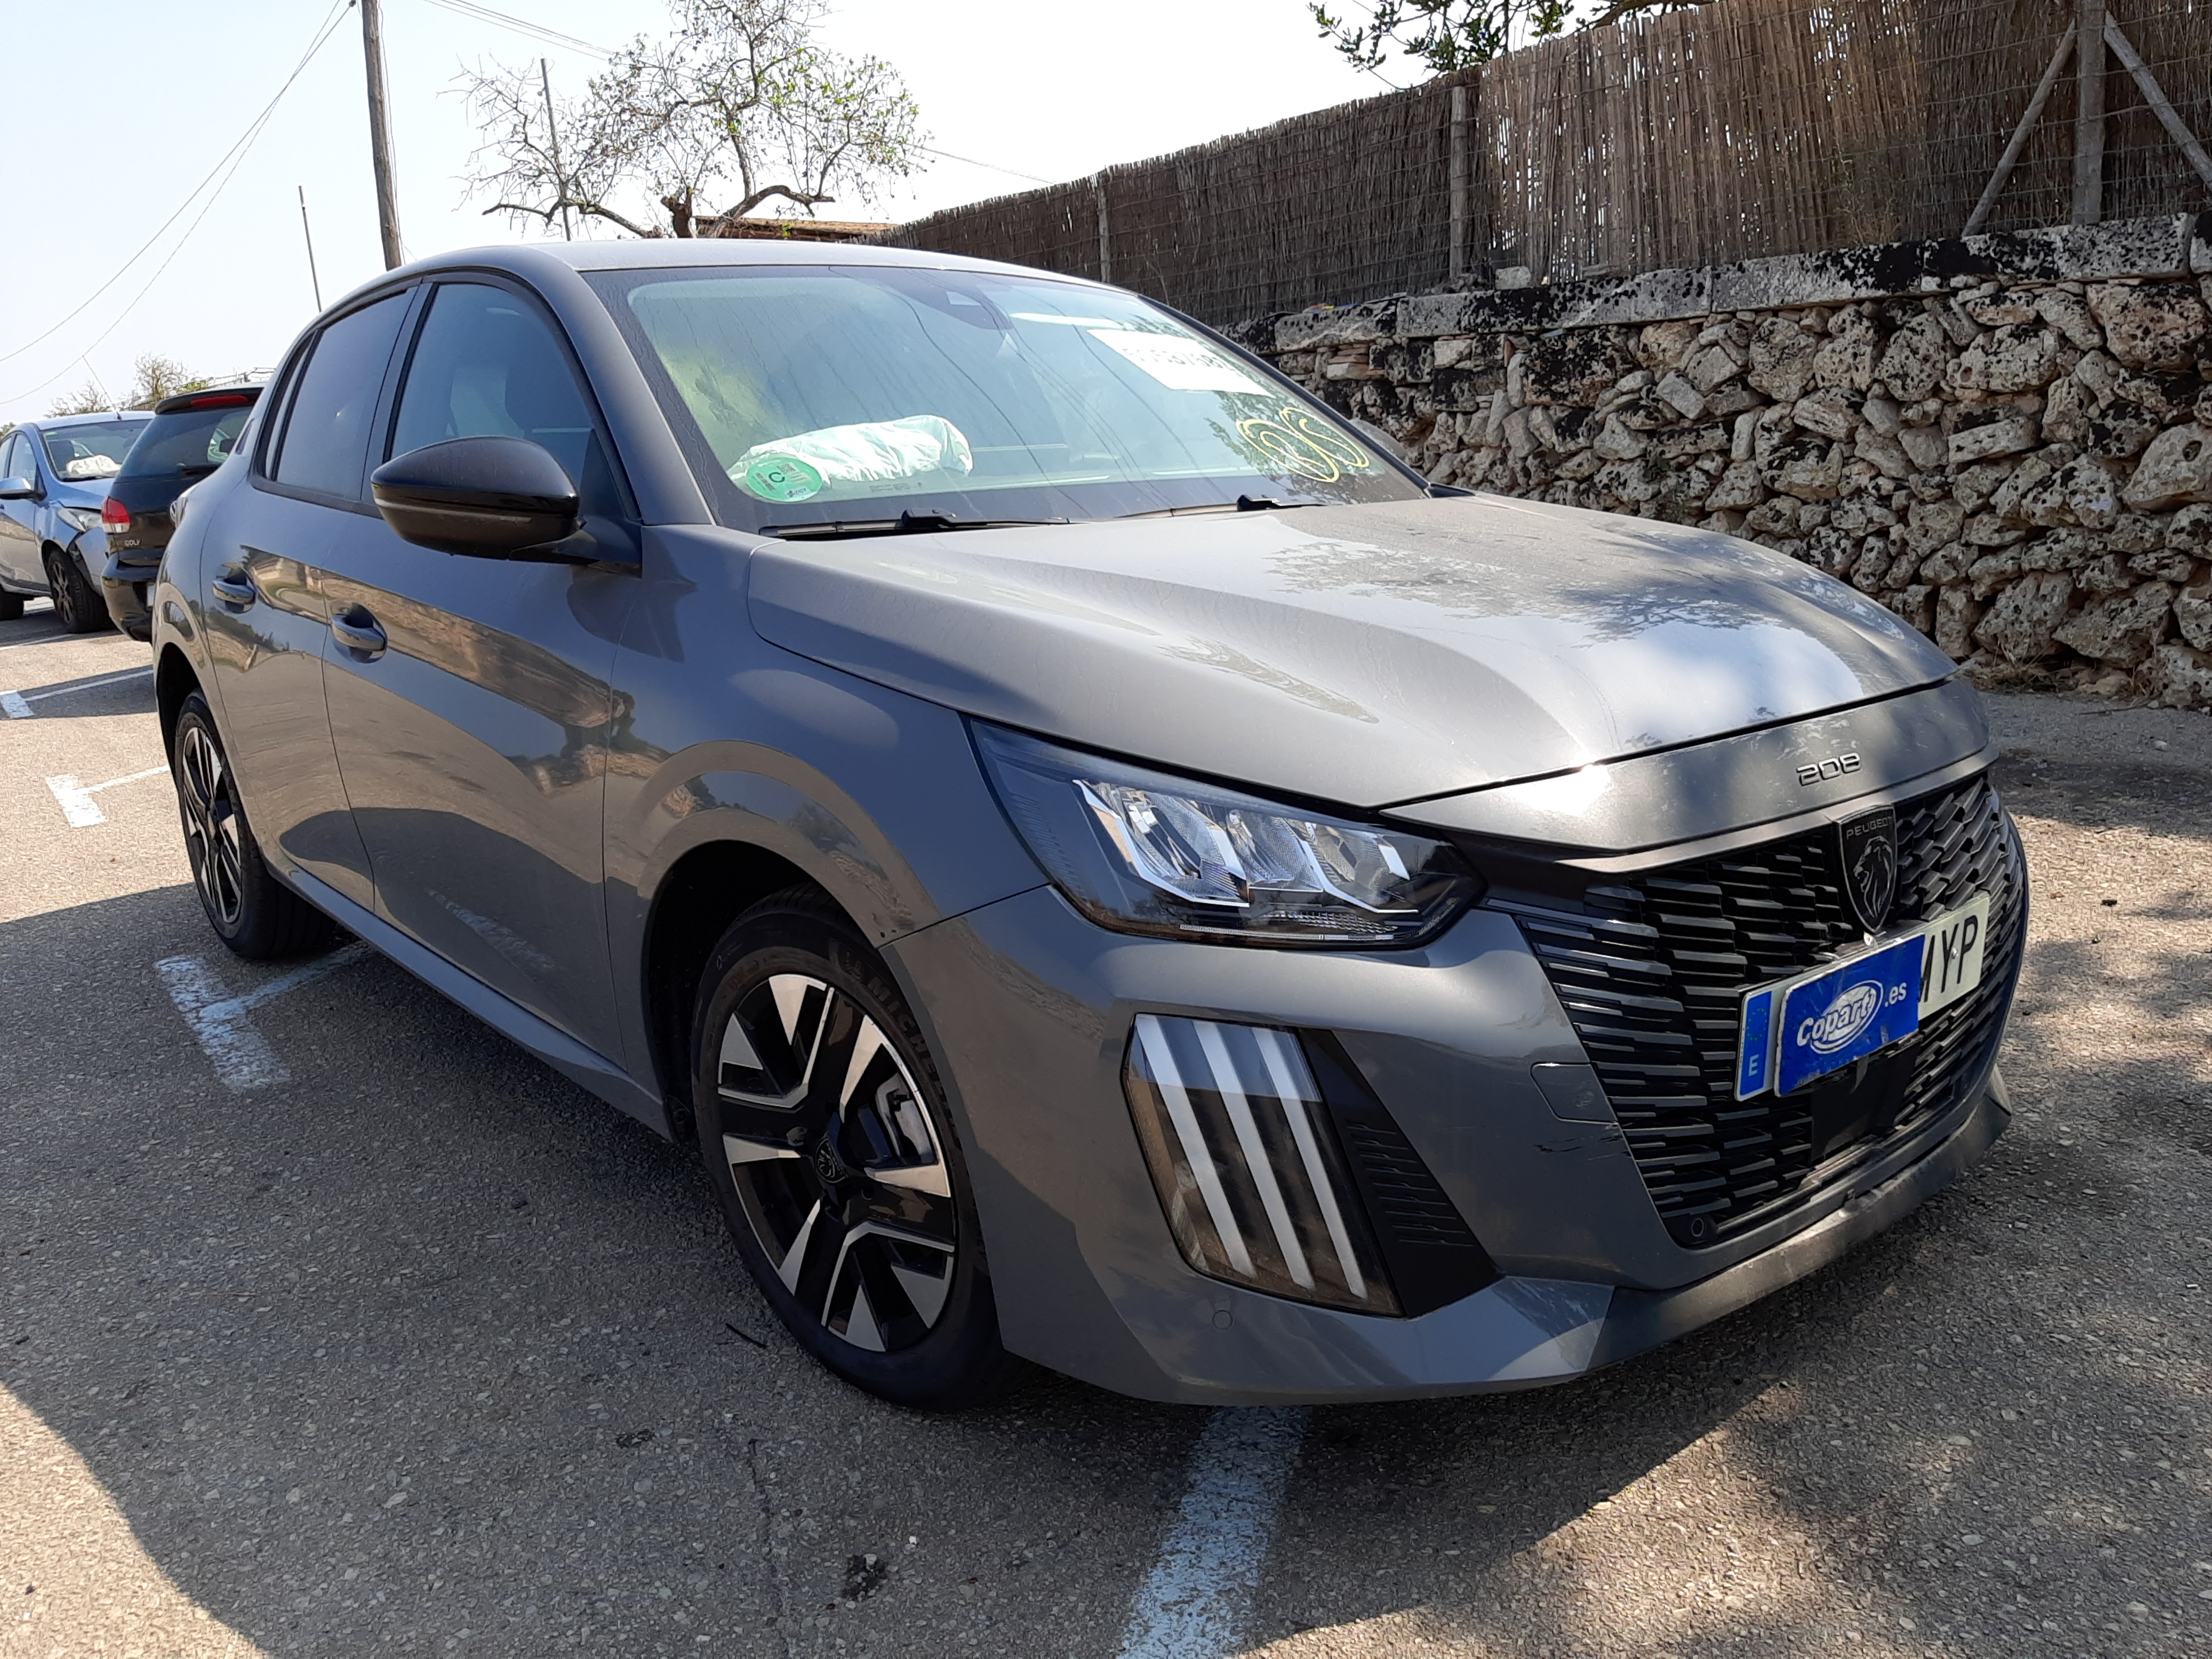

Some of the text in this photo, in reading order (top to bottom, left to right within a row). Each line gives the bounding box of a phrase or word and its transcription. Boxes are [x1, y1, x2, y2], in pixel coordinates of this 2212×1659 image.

[768, 472, 785, 483] C
[1796, 752, 1861, 786] 208
[1846, 816, 1892, 840] PEUGEOT
[1796, 988, 1875, 1046] Copart
[1748, 1054, 1759, 1077] E
